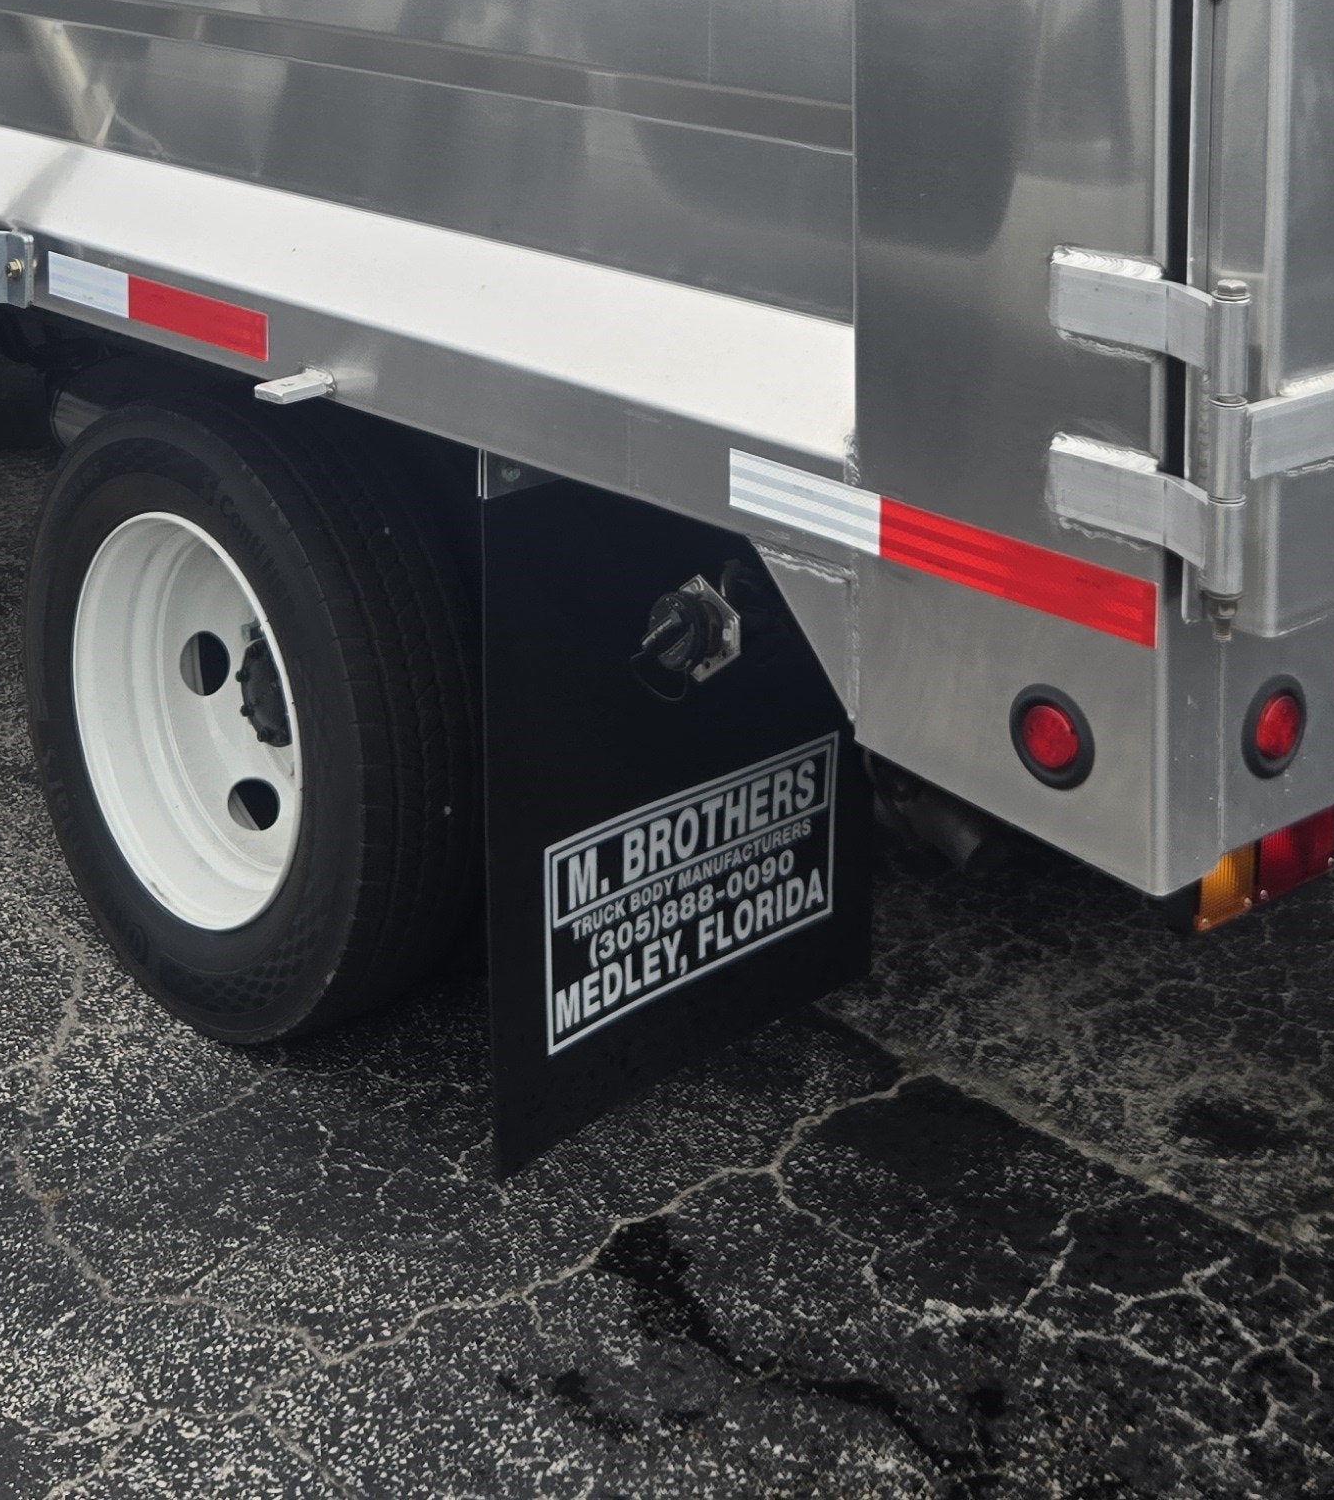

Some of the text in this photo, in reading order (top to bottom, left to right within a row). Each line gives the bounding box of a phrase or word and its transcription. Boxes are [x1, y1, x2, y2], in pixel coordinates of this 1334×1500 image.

[568, 759, 816, 910] M. BROTHERS
[571, 817, 813, 940] TRUCK BODY MANUFACTURERS
[555, 867, 825, 1035] MEDLEY, FLORIDA
